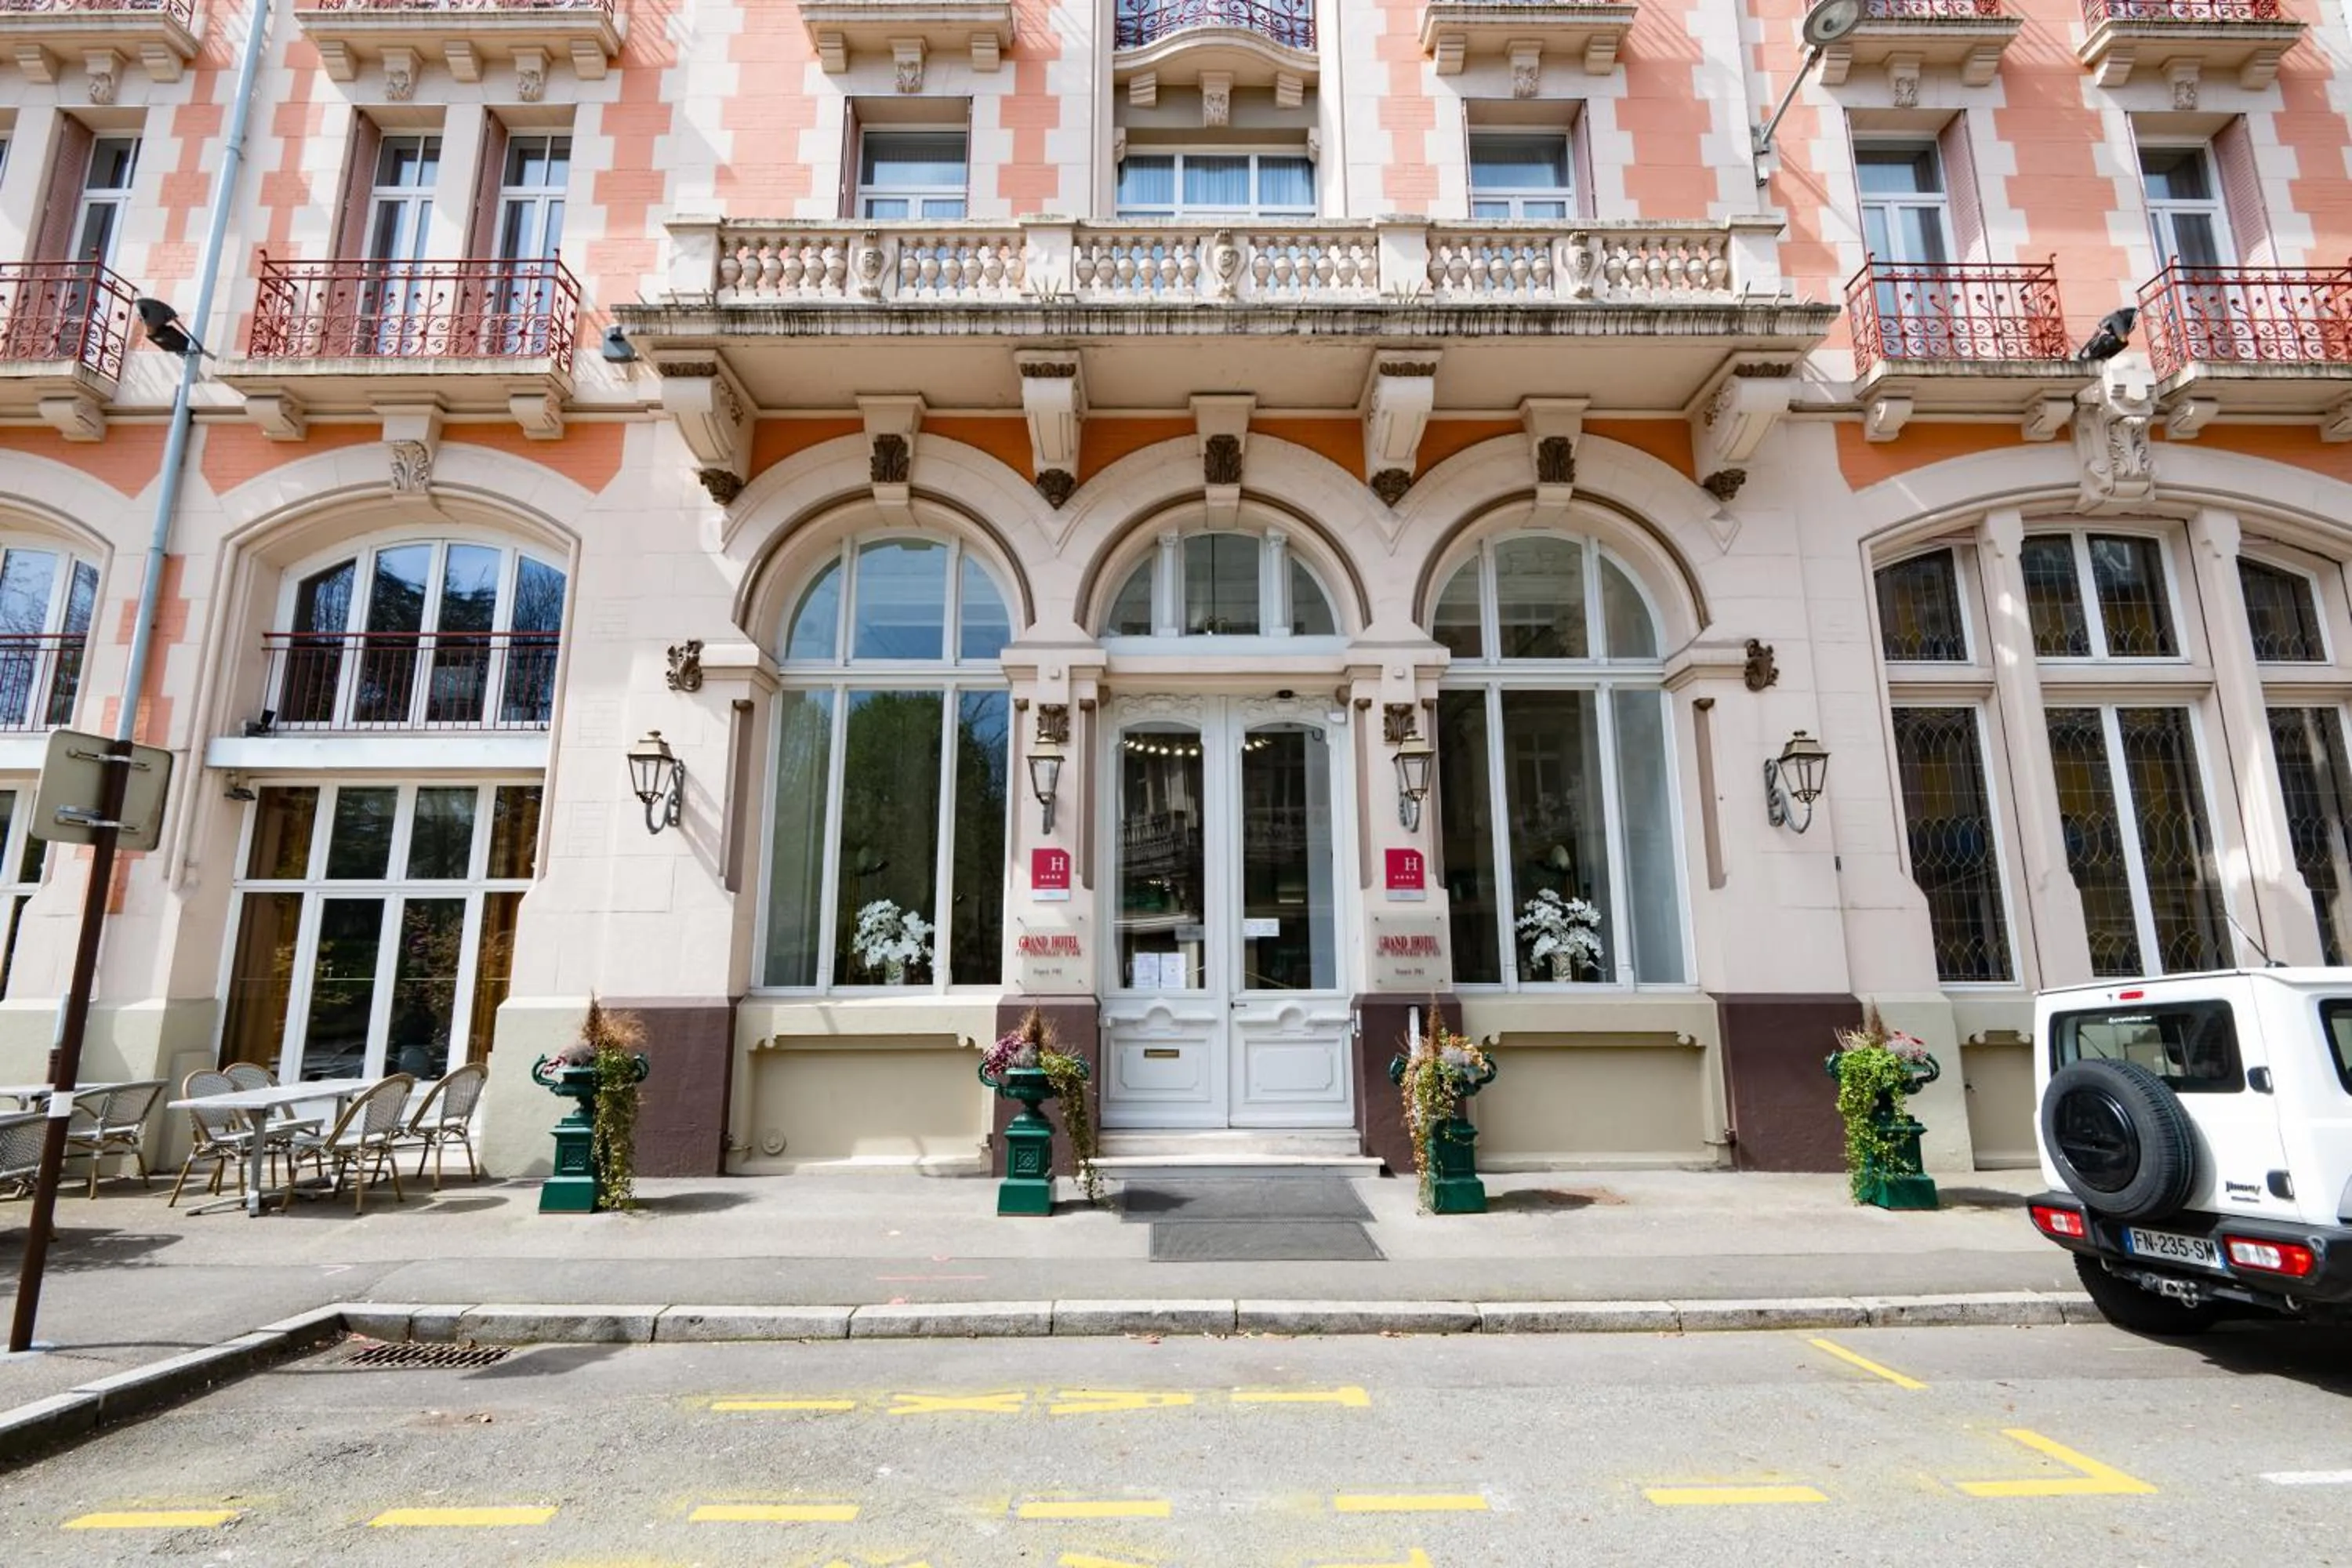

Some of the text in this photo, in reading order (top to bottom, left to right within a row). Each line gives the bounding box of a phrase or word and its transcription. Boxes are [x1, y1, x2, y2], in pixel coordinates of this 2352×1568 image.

[1051, 856, 1065, 871] H
[1404, 856, 1418, 871] H
[1018, 935, 1048, 949] GRAND
[1378, 935, 1407, 949] GRAND
[2133, 1230, 2217, 1261] FN-235-SM
